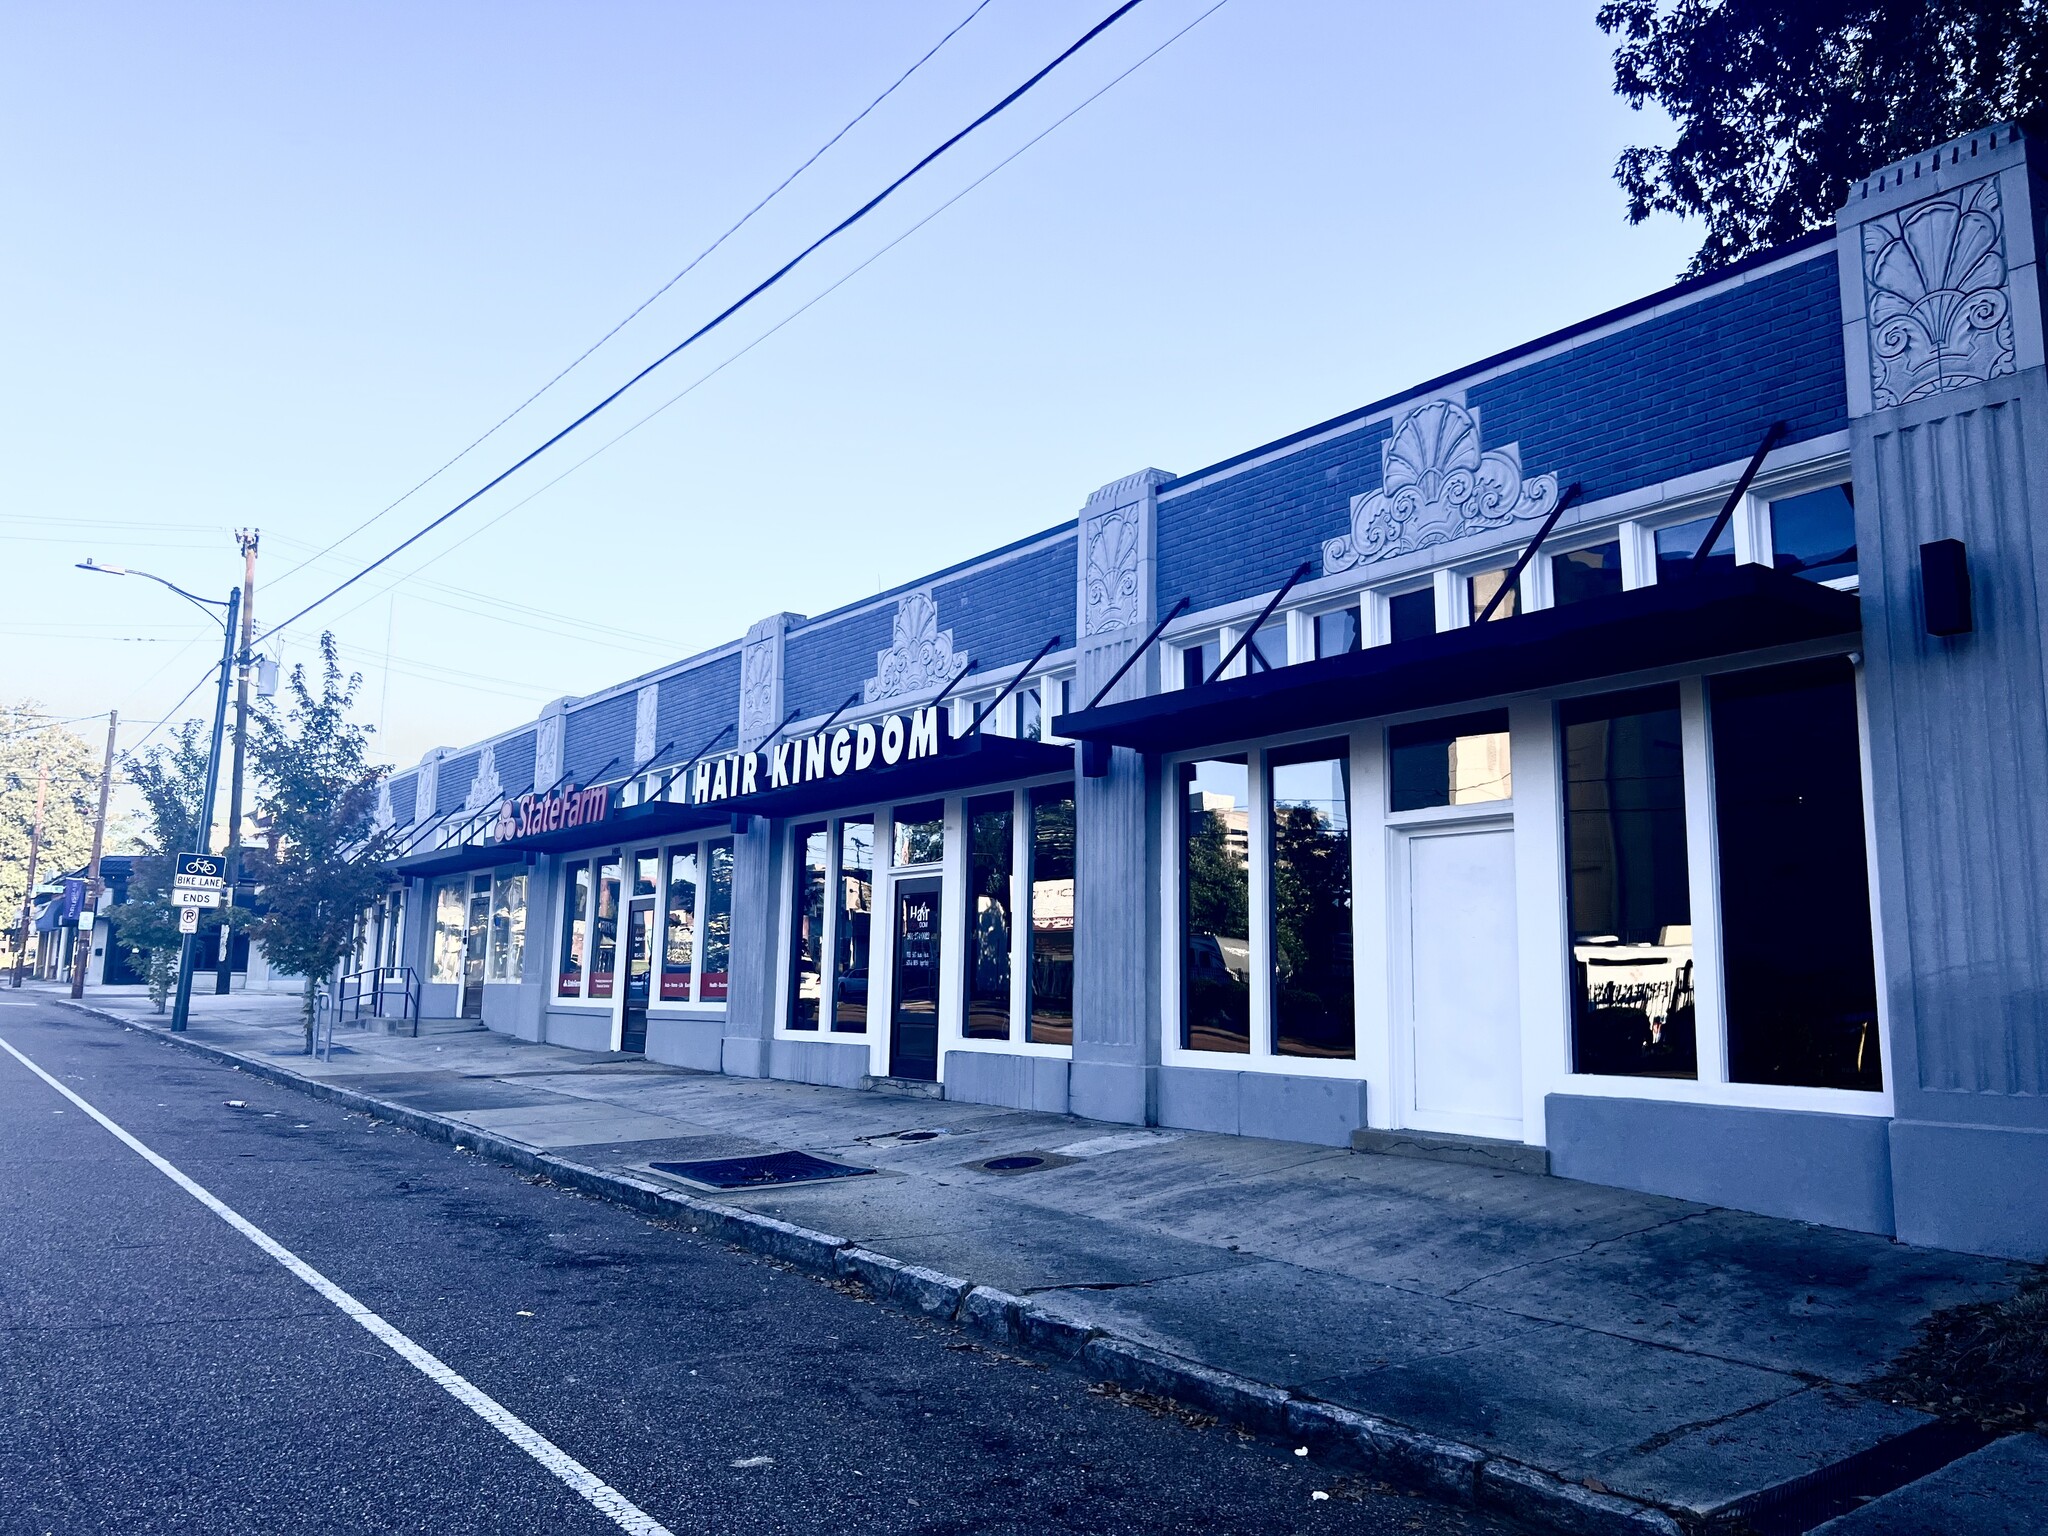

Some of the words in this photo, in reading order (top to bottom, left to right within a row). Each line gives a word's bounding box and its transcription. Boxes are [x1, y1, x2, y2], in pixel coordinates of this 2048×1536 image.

[694, 752, 758, 805] HAIR
[771, 706, 938, 788] KINGDOM
[177, 876, 197, 885] BIKE
[198, 879, 221, 888] LANE
[183, 894, 210, 903] ENDS
[910, 902, 930, 921] Hair
